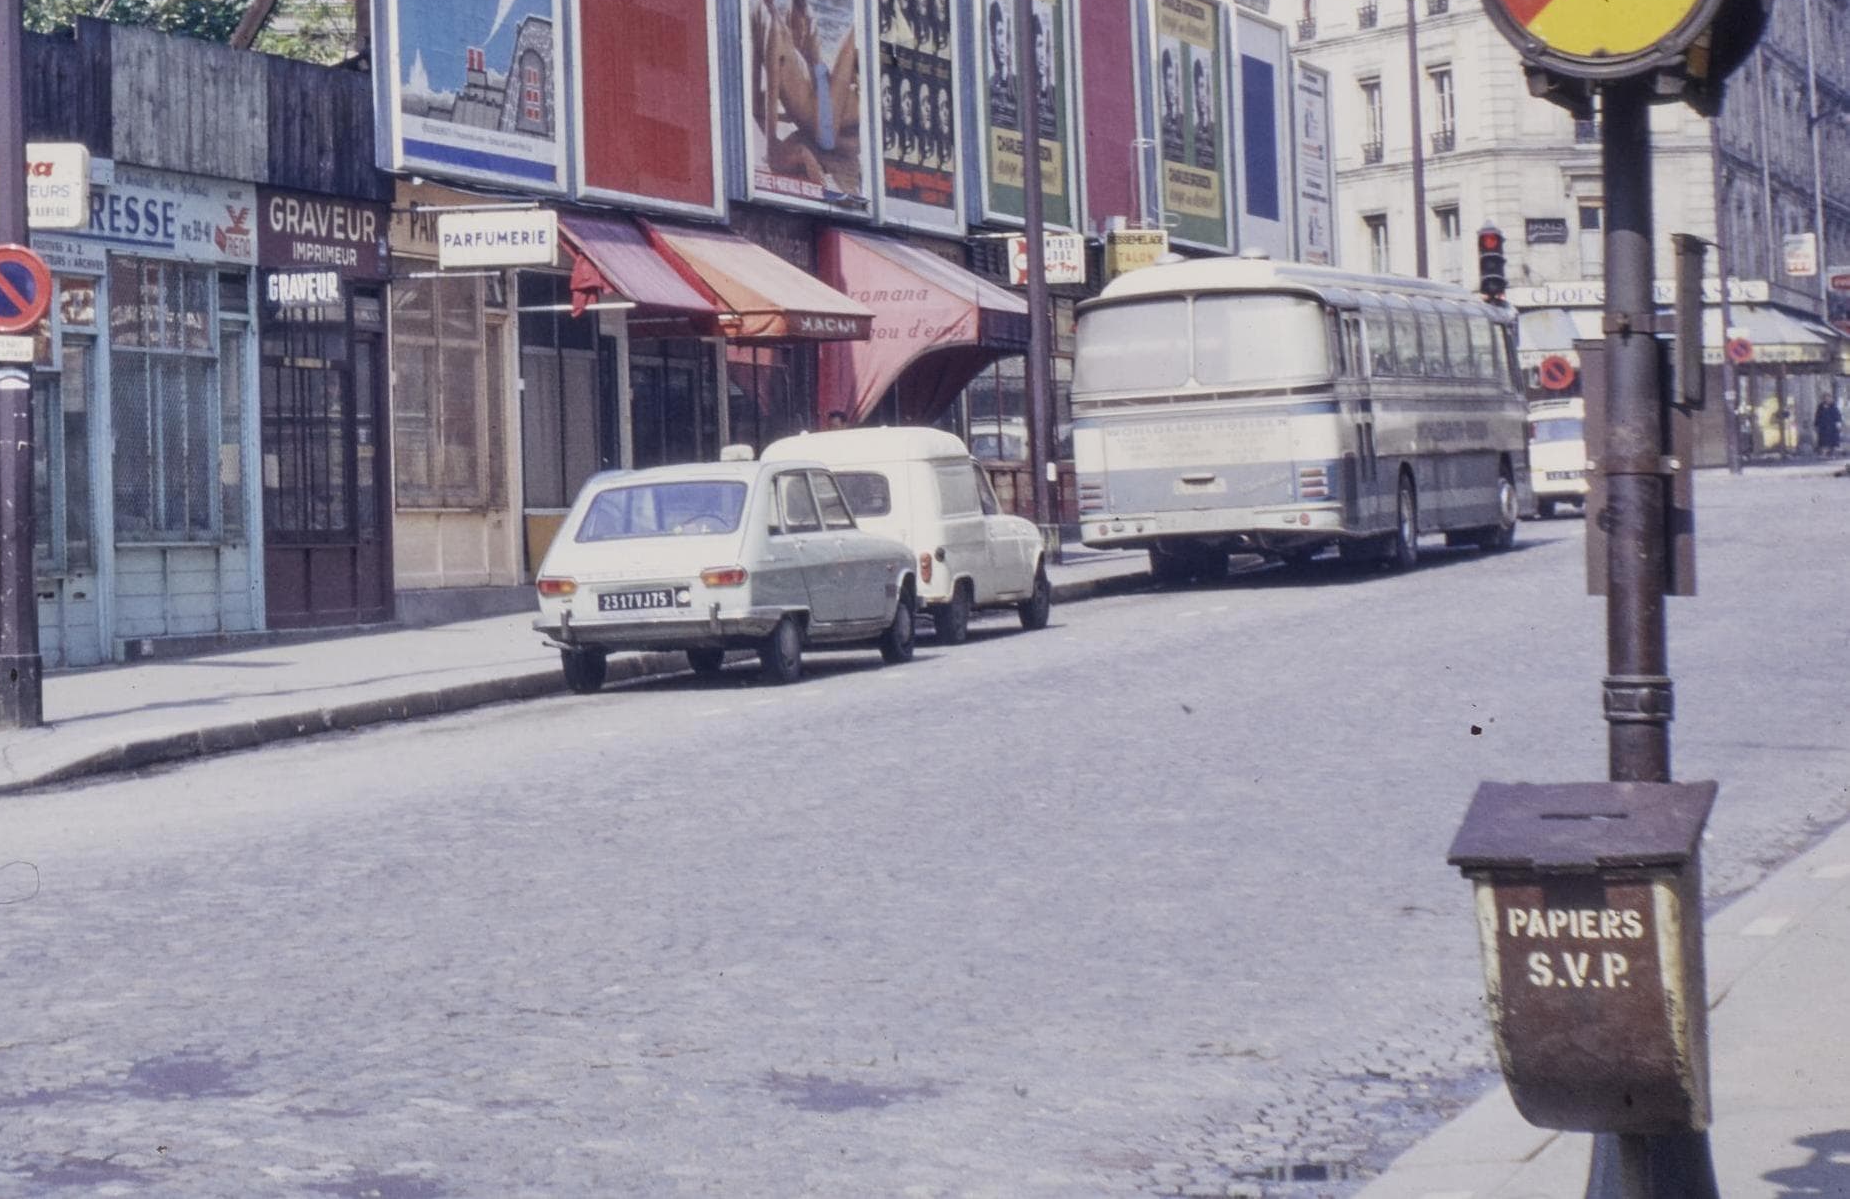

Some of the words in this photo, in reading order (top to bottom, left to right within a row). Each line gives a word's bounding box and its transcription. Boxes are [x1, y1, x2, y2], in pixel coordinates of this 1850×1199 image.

[269, 196, 376, 243] GRAVEUR
[444, 230, 547, 248] PARFUMERIE
[1108, 233, 1164, 246] RESSEMELAGE
[292, 241, 357, 266] IMPRIMEUR
[268, 271, 340, 303] GRAVEUR
[603, 591, 668, 610] 2317VJ75
[1507, 908, 1644, 939] PAPIERS
[1527, 951, 1631, 989] S.V.P.
